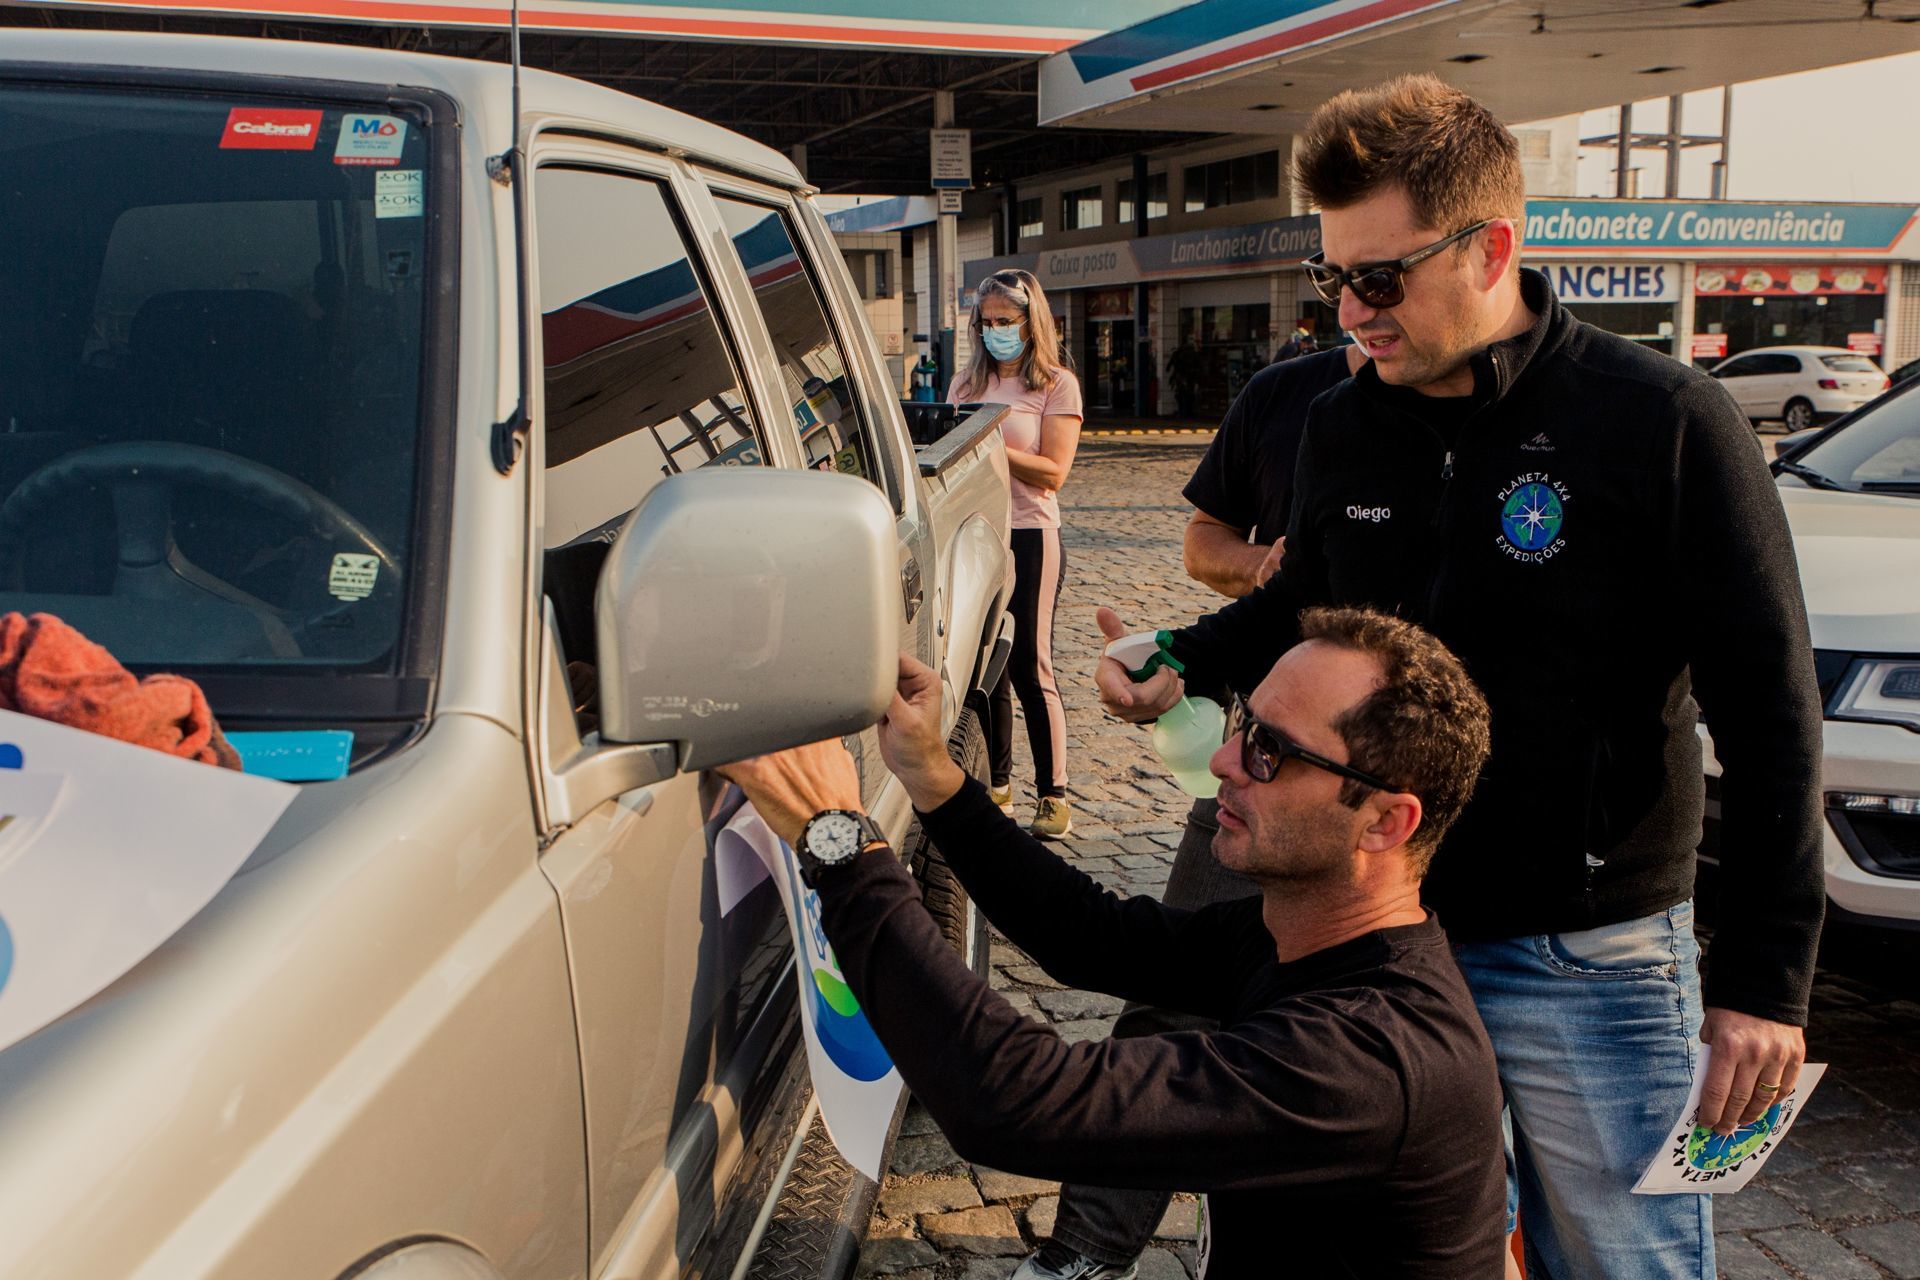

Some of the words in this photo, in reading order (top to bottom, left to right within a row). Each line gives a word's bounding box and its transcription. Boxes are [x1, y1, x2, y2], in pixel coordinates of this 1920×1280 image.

[233, 121, 312, 137] Cabral
[393, 172, 421, 182] OK
[393, 195, 421, 205] OK
[1524, 207, 1653, 241] nchonete
[1679, 209, 1846, 242] Conveniência
[1171, 235, 1257, 264] Lanchonete
[1268, 226, 1322, 254] Conve
[1050, 254, 1080, 276] Caixa
[1082, 252, 1117, 279] posto
[1498, 472, 1549, 502] PLANETA
[1346, 504, 1391, 523] Diego
[1496, 535, 1566, 564] EXPEDIÇÕES
[1681, 1141, 1772, 1182] PLANETA
